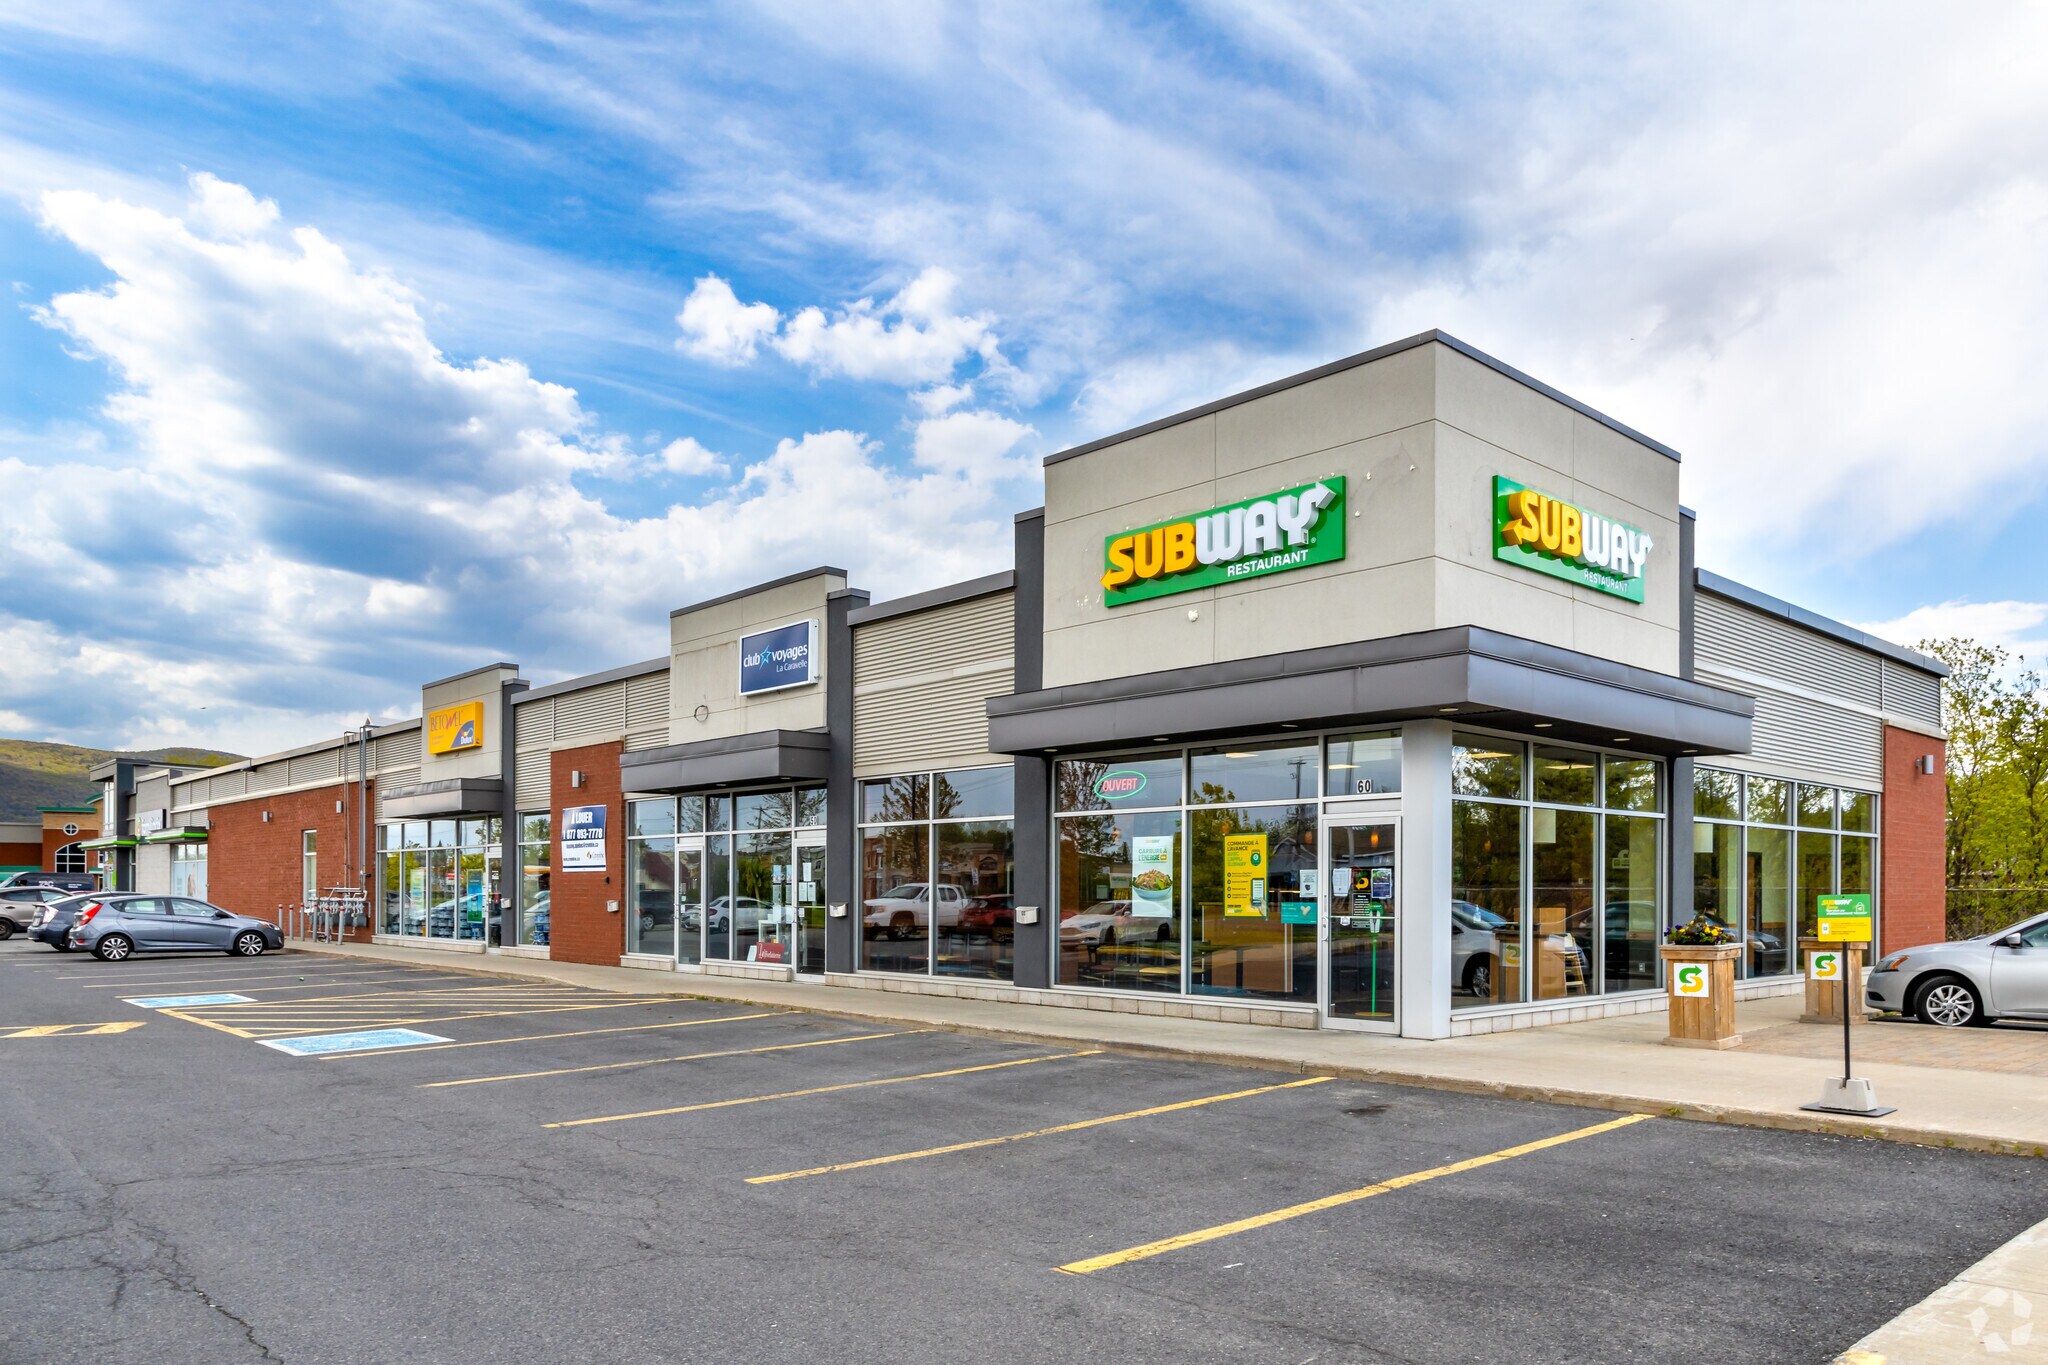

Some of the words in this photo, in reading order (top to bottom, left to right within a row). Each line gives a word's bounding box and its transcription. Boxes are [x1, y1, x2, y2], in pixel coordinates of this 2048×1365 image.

[1100, 481, 1337, 592] SUBWAY
[1502, 489, 1654, 580] SUBWAY
[1227, 549, 1309, 577] RESTAURANT
[1584, 570, 1628, 593] RESTAURANT
[743, 652, 760, 667] club
[771, 644, 808, 662] voyages
[776, 664, 783, 672] La
[784, 660, 808, 671] Caravelle
[1102, 778, 1137, 792] OUVERT
[1357, 780, 1371, 793] 60
